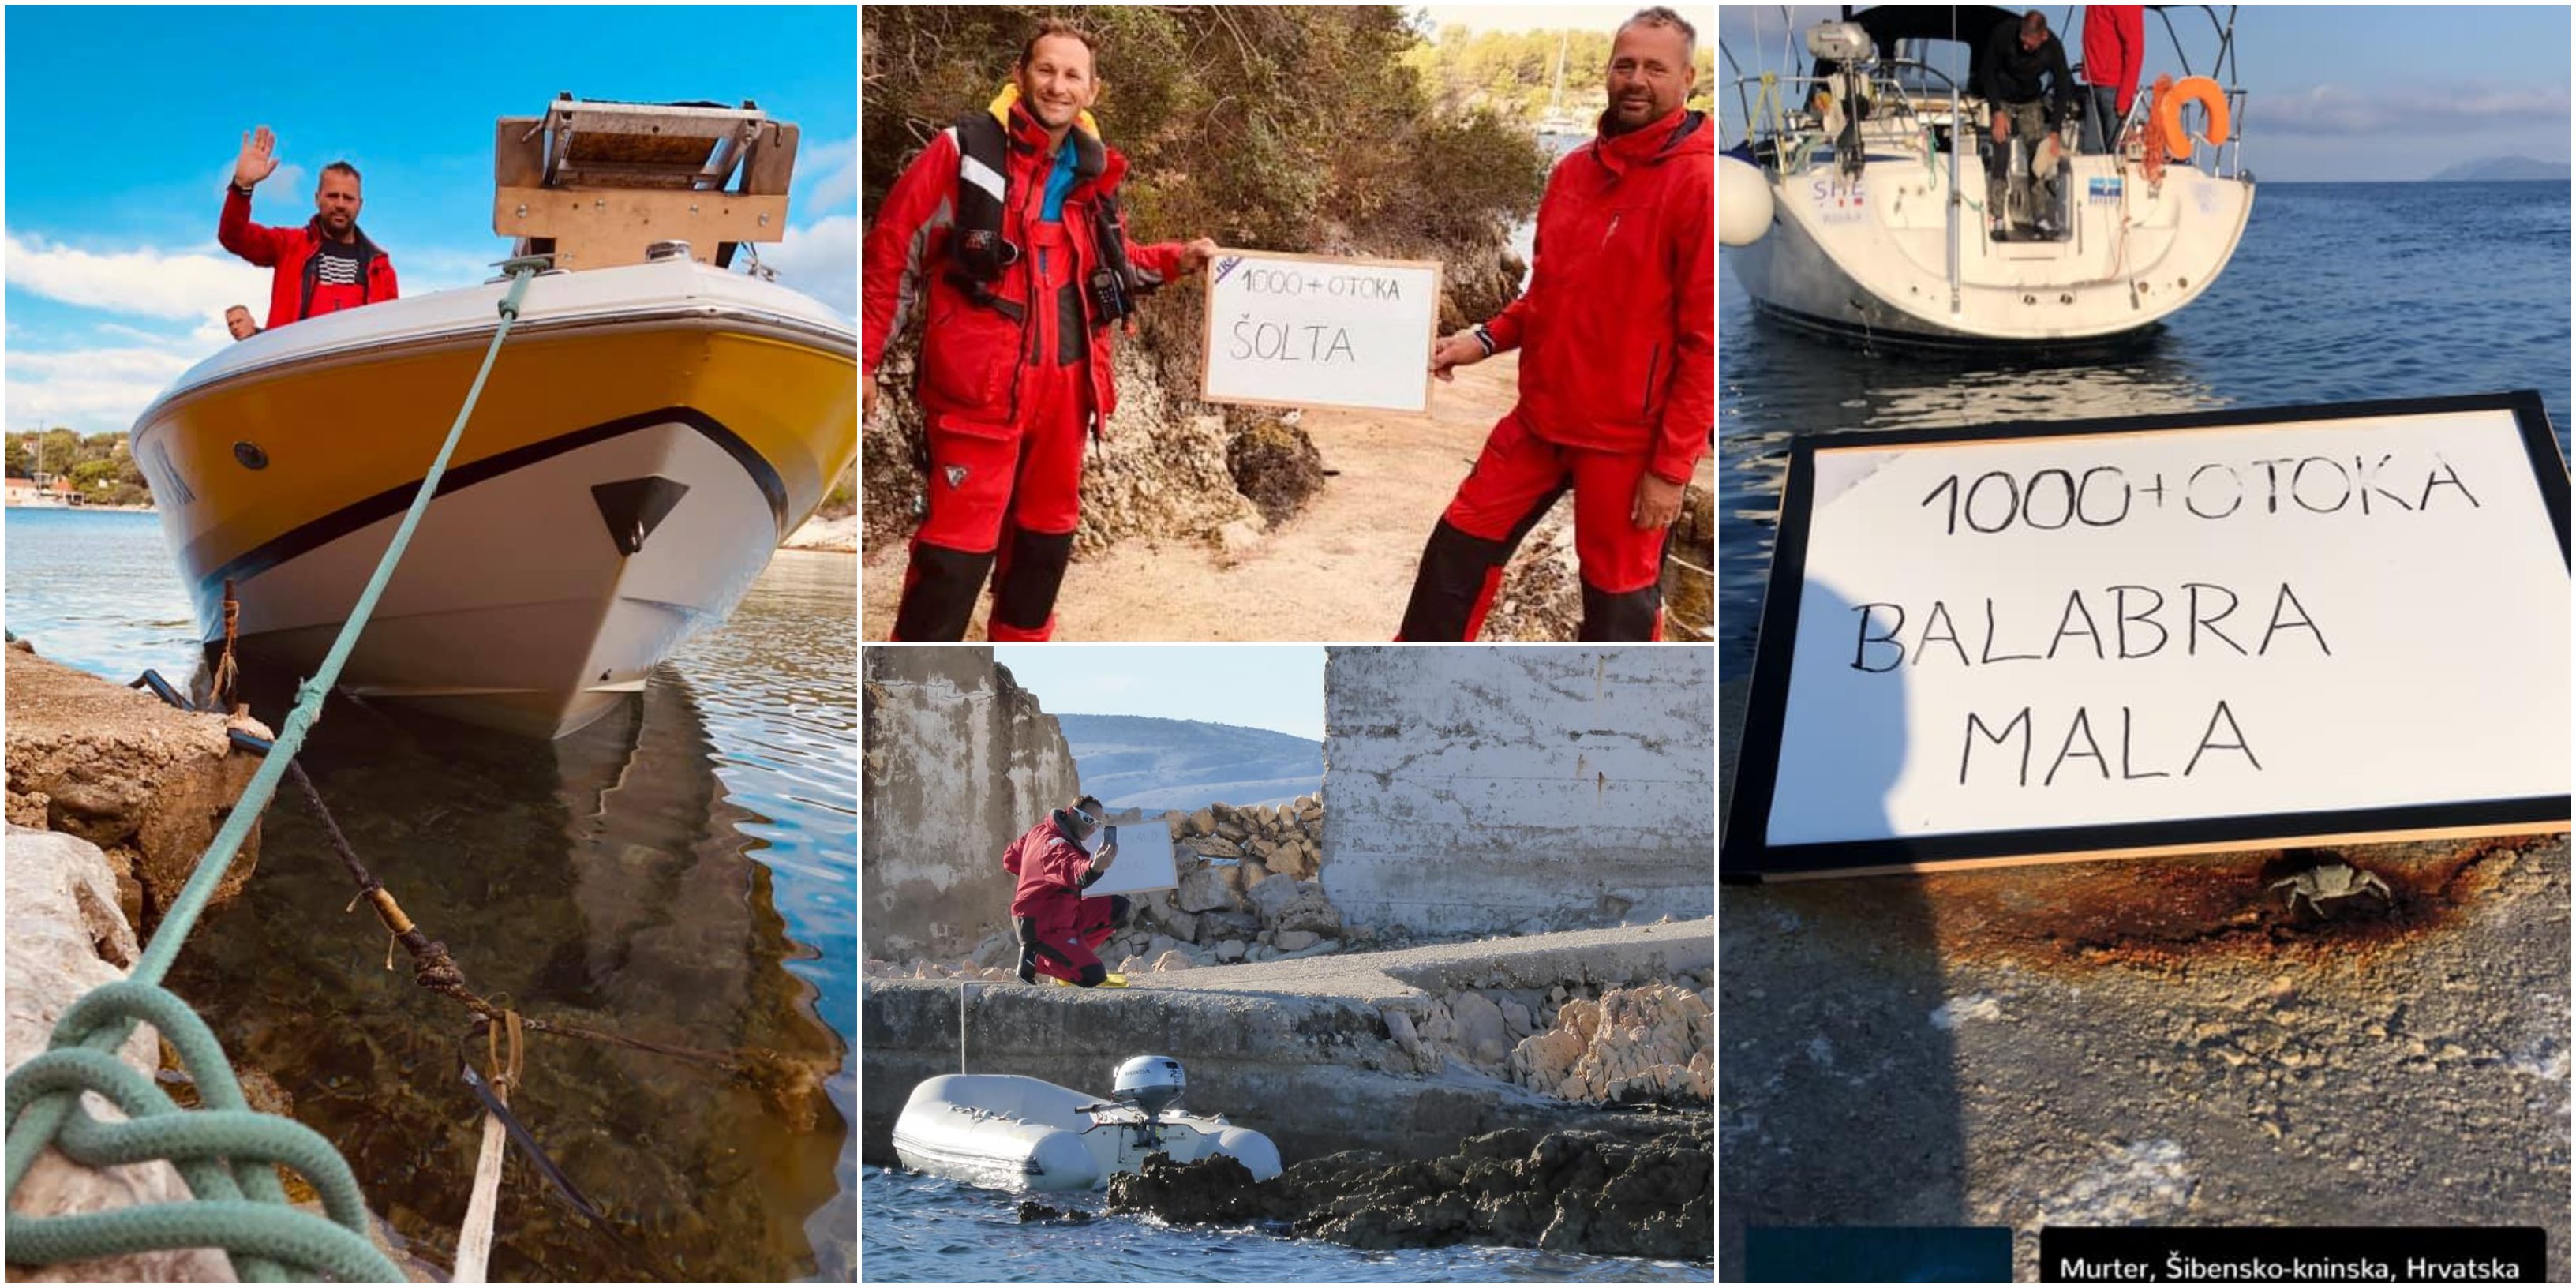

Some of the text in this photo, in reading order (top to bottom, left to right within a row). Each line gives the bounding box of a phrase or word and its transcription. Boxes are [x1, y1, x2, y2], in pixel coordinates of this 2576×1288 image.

[1328, 276, 1400, 300] OTOKA
[1230, 313, 1355, 363] ŠOLTA
[2185, 453, 2481, 519] OTOKA
[1850, 582, 2332, 674] BALABRA
[1960, 699, 2263, 788] MALA
